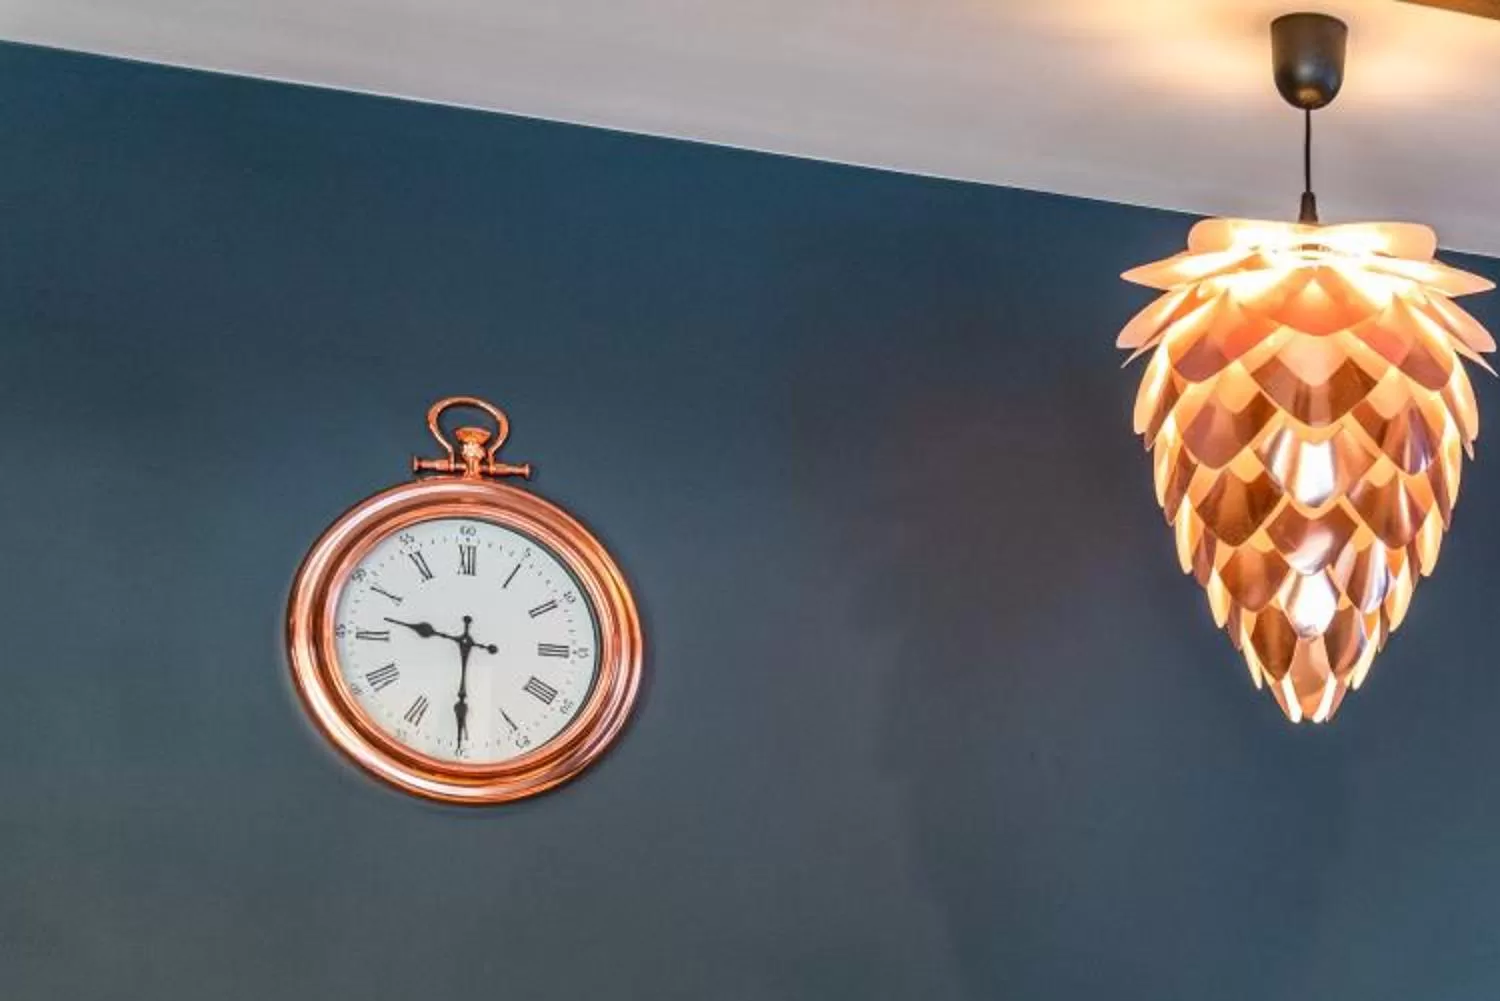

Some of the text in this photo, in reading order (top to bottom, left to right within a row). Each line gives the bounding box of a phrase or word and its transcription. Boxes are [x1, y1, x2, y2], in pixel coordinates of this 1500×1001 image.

[460, 525, 477, 536] 60
[457, 544, 477, 576] XII
[501, 562, 522, 590] I
[527, 599, 559, 618] II
[538, 643, 570, 659] III
[523, 675, 559, 706] IIII
